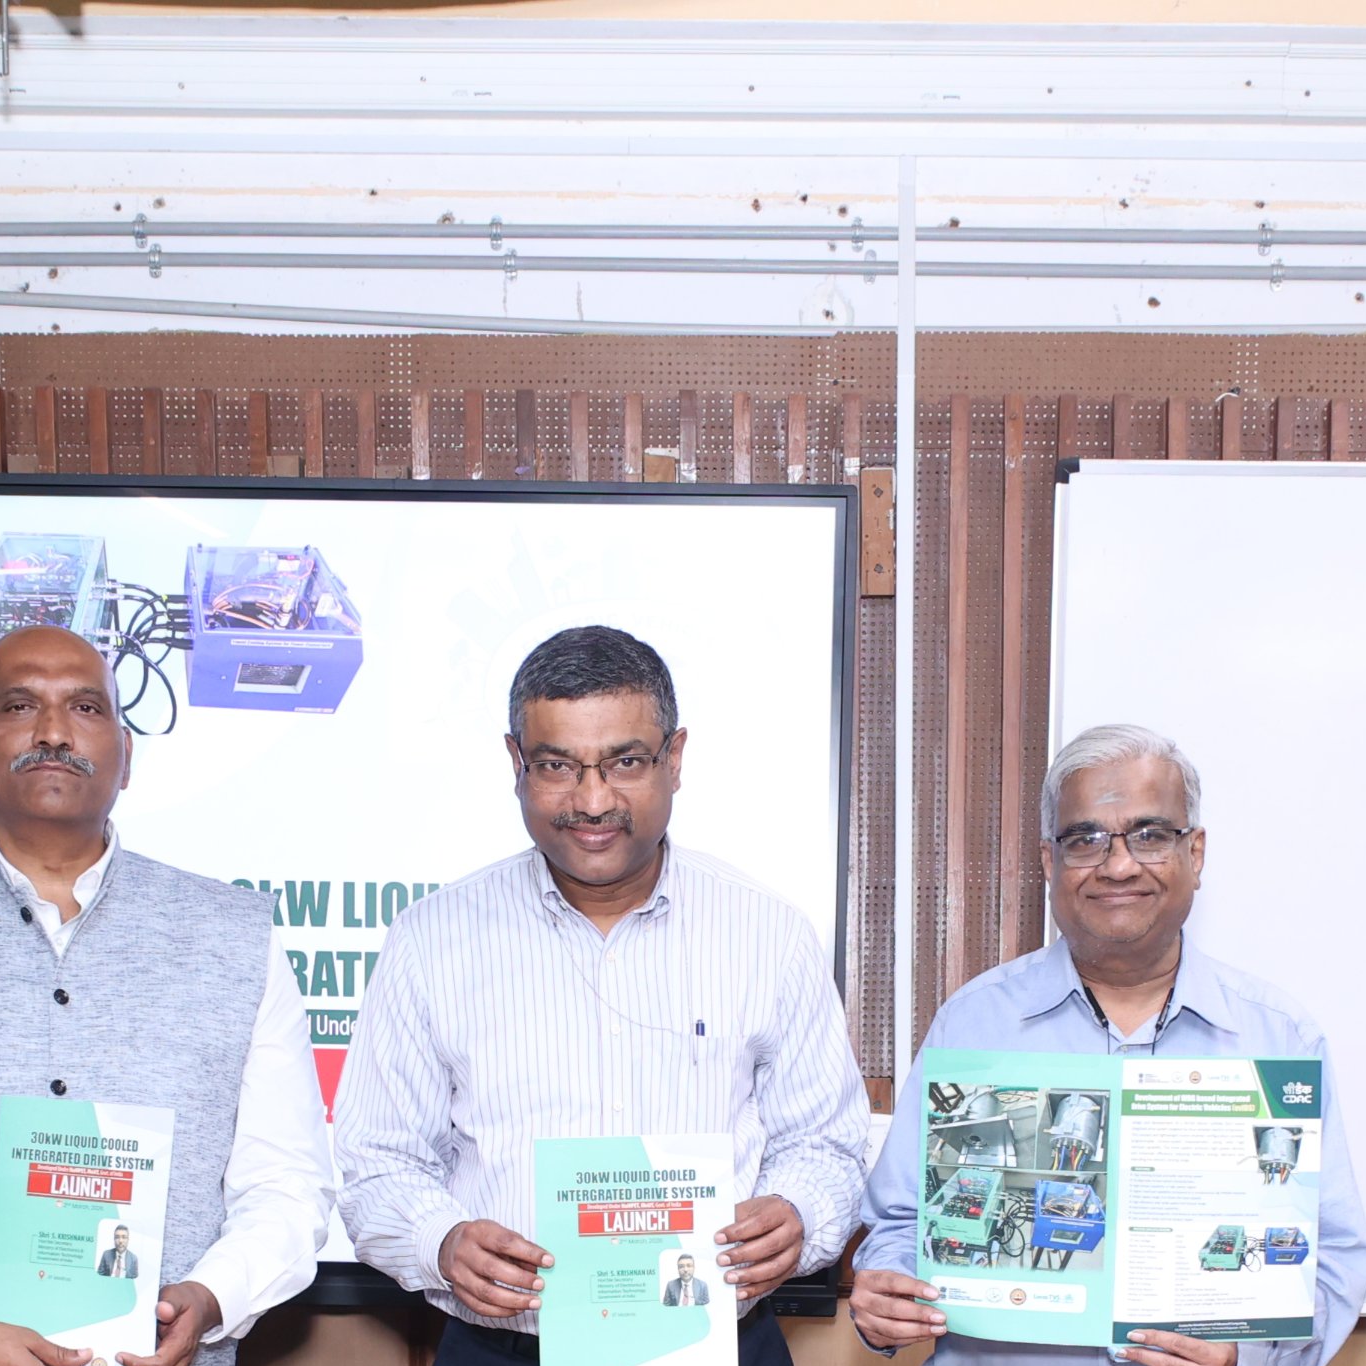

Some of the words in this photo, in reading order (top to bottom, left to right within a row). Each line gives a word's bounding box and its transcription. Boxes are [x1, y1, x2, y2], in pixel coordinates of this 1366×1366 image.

[30, 1131, 62, 1145] 30kW
[64, 1134, 98, 1148] LIQUID
[100, 1137, 138, 1152] COOLED
[11, 1147, 80, 1166] INTERGRATED
[83, 1153, 112, 1167] DRIVE
[115, 1155, 154, 1170] SYSTEM
[50, 1174, 112, 1199] LAUNCH
[575, 1171, 609, 1184] 30kW
[612, 1170, 650, 1184] LIQUID
[653, 1169, 695, 1182] COOLED
[557, 1188, 632, 1201] INTERGRATED
[635, 1187, 668, 1199] DRIVE
[671, 1185, 715, 1199] SYSTEM
[603, 1210, 670, 1232] LAUNCH
